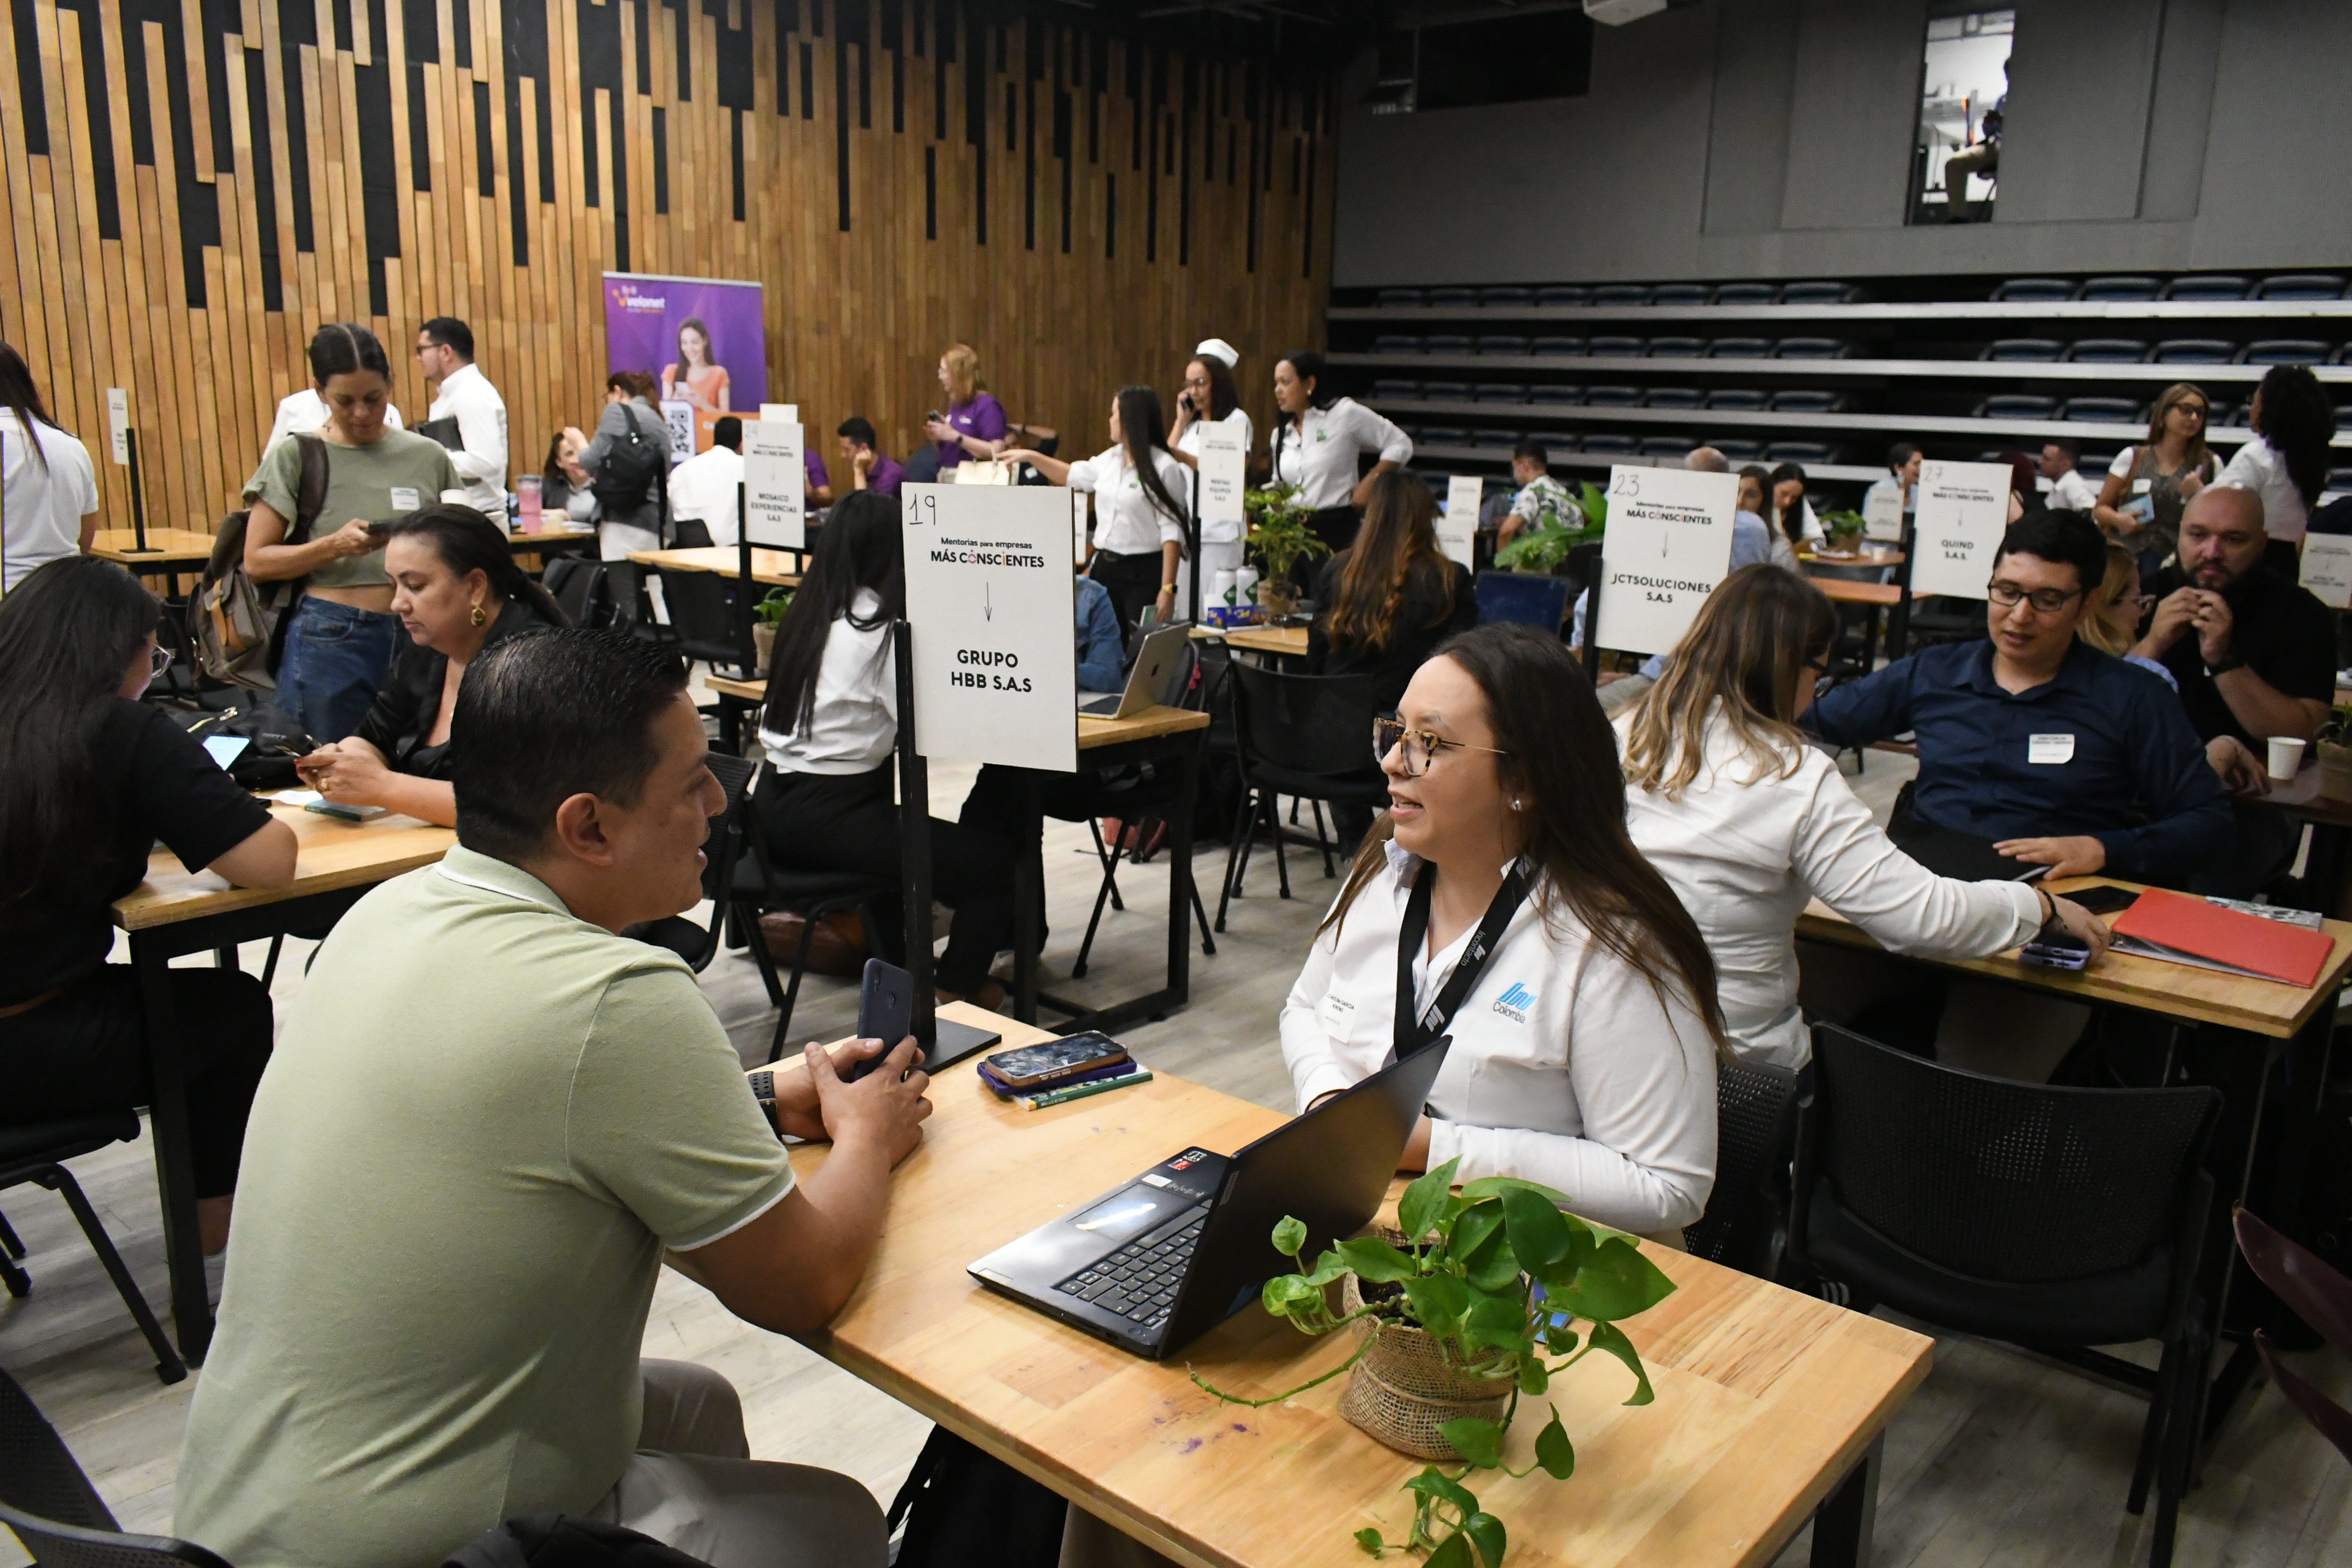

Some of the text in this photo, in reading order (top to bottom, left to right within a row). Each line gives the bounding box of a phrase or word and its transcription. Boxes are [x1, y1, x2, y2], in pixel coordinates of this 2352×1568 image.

[1614, 474, 1639, 496] 23
[758, 493, 789, 502] MOSAICO
[751, 502, 797, 513] EXPERIENCIAS
[909, 493, 936, 525] 19
[1627, 509, 1646, 517] MÁS
[995, 541, 1032, 550] empresas
[1941, 539, 1974, 550] QUIND
[931, 549, 957, 563] MÁS
[1611, 573, 1712, 593] JCTSOLUCIONES
[1647, 592, 1673, 603] S.A.S
[957, 649, 1018, 668] GRUPO
[951, 671, 1032, 693] HBB S.A.S
[1460, 930, 1486, 966] Incontacto
[1493, 1001, 1526, 1024] Colombia
